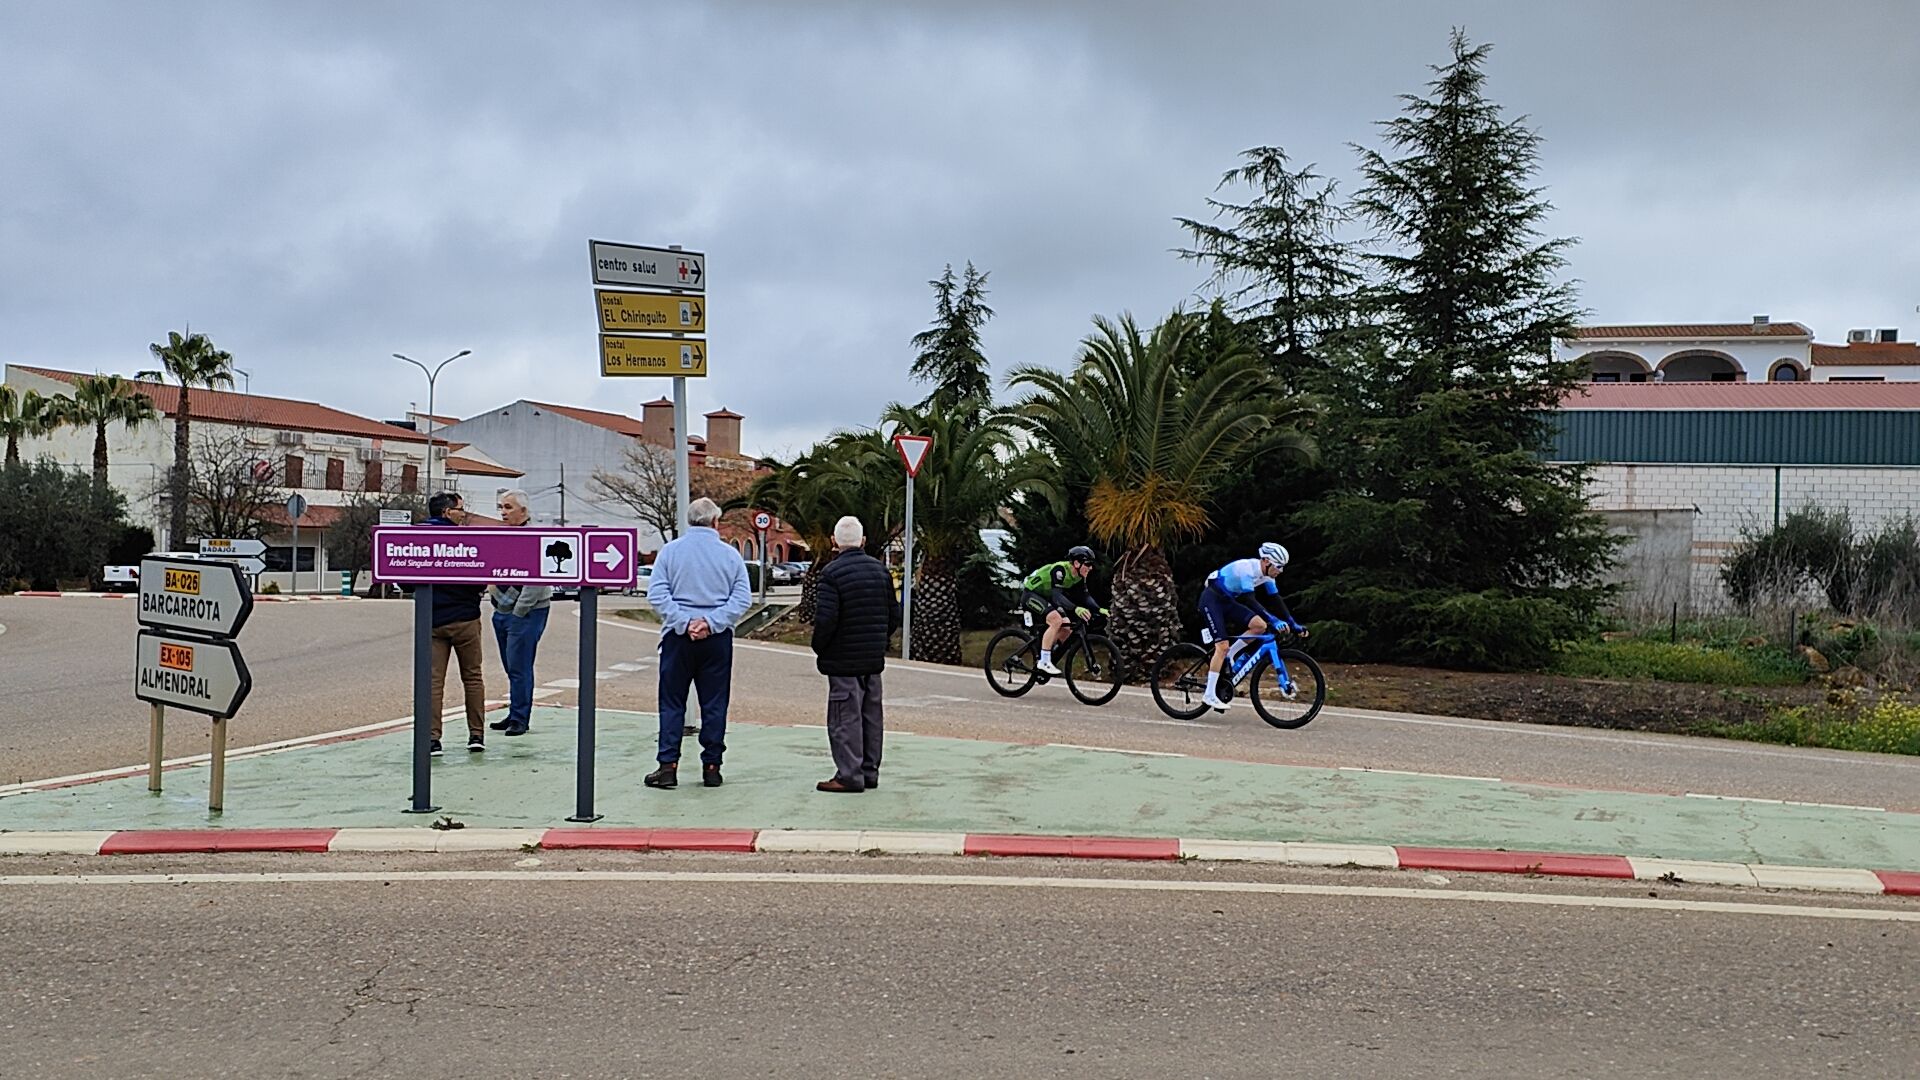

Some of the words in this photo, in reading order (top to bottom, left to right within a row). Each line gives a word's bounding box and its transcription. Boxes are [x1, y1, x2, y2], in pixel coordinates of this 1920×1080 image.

[598, 258, 628, 271] centro
[632, 261, 657, 274] salud
[602, 296, 623, 306] hostal
[604, 309, 617, 323] EL
[621, 309, 667, 326] Chiringuito
[606, 340, 625, 349] hostal
[606, 353, 622, 366] Los
[626, 354, 666, 367] Hermanos
[757, 517, 768, 525] 30
[386, 542, 430, 557] Encina
[433, 542, 478, 558] Madre
[389, 558, 406, 567] Árbol
[407, 559, 433, 568] Singular
[443, 560, 485, 568] Extremadura
[165, 569, 198, 591] BA-026
[492, 568, 508, 577] 11,5
[510, 569, 529, 577] Kms
[143, 593, 220, 621] BARCARROTA
[160, 647, 191, 667] EX-105
[1232, 650, 1262, 686] GIANT
[141, 667, 211, 700] ALMENDRAL
